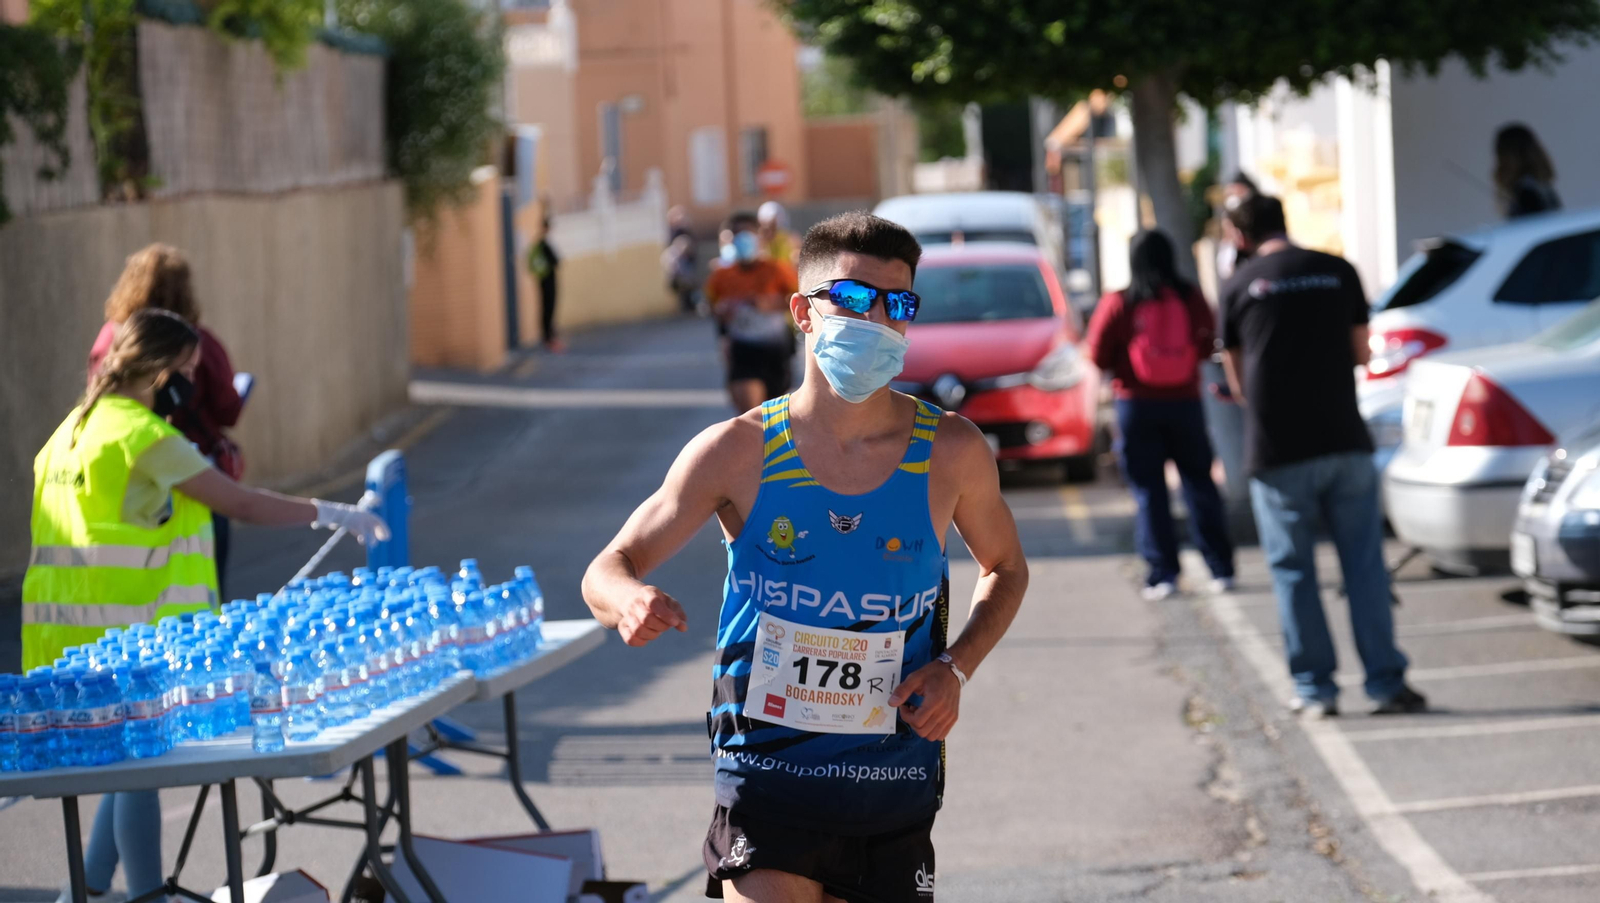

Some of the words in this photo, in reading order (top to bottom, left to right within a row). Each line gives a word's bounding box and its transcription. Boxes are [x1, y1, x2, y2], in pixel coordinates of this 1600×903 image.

[730, 570, 938, 622] HISPASUR
[792, 643, 827, 658] CARRERAS
[828, 650, 867, 661] POPULARES
[794, 630, 839, 649] CIRCUITO
[842, 638, 868, 652] 2020
[763, 651, 779, 664] S20
[793, 656, 862, 690] 178
[786, 684, 865, 706] BOGARROSKY
[867, 677, 883, 694] R
[717, 747, 927, 783] www.grupohispasur.es
